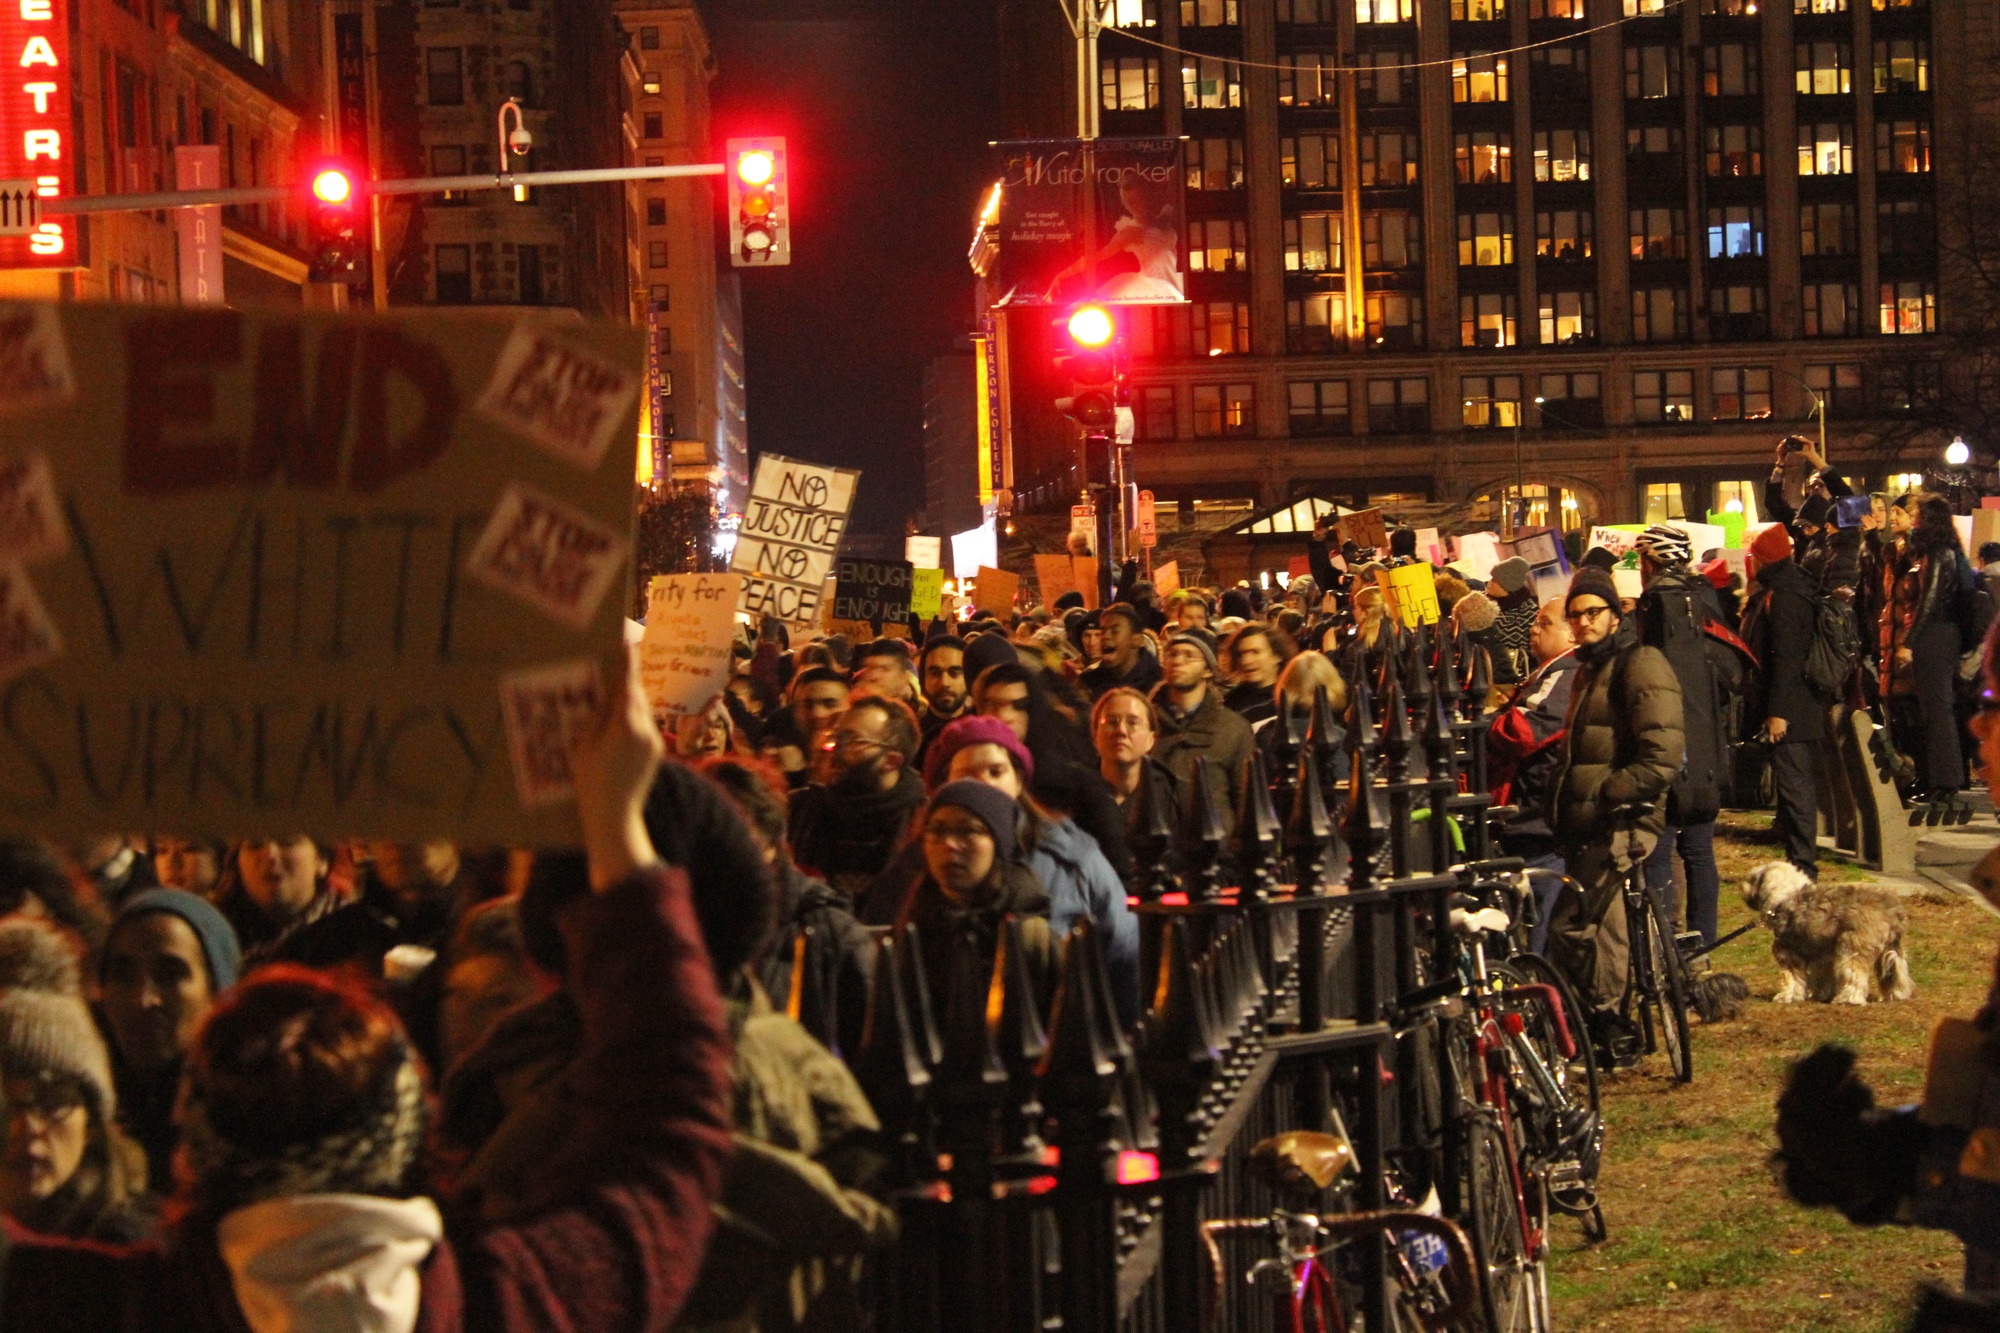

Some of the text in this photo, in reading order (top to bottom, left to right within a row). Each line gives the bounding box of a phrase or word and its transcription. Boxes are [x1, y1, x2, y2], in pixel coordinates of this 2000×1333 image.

[1011, 230, 1074, 244] holiday magic
[122, 313, 461, 495] END
[650, 312, 663, 471] EMERSON COLLEGE
[986, 321, 1001, 484] EMERSON COLLEGE
[778, 471, 828, 508] NO
[746, 501, 844, 547] JUSTICE
[756, 543, 809, 579] NO
[840, 563, 912, 587] ENOUGH
[693, 577, 726, 601] for
[835, 597, 911, 623] ENOUGH
